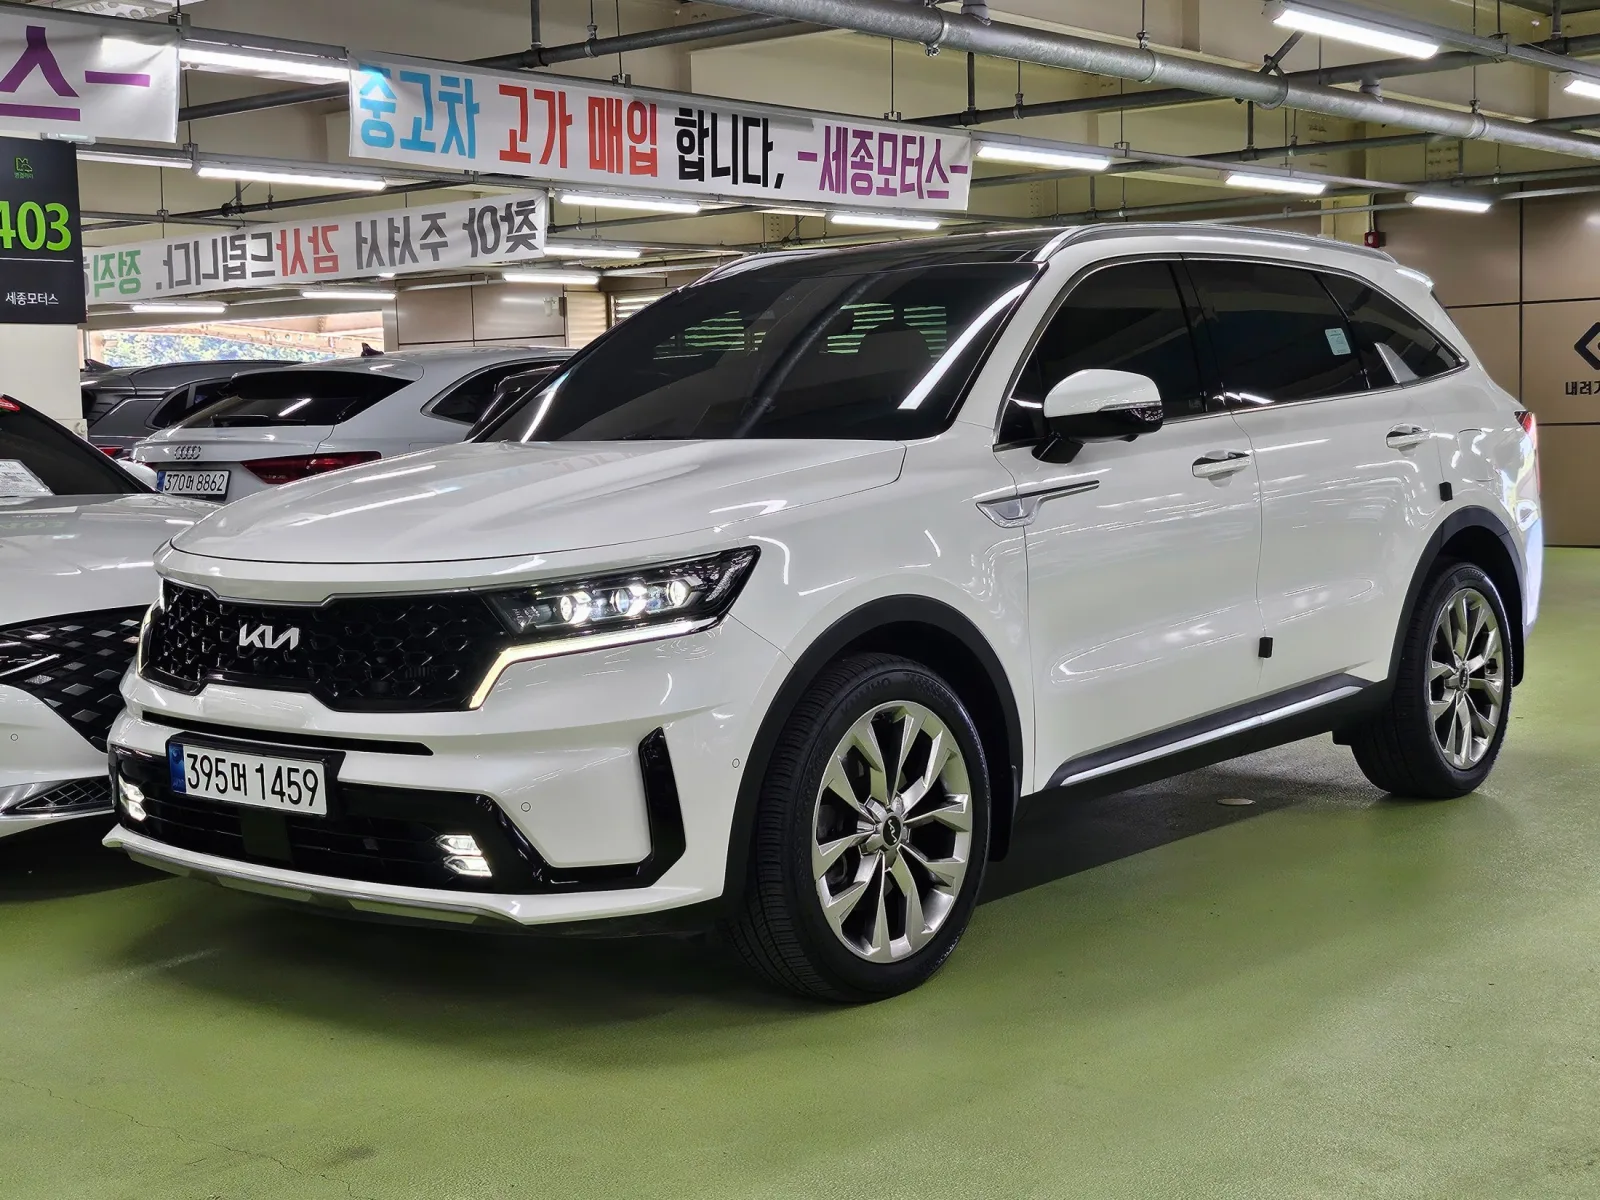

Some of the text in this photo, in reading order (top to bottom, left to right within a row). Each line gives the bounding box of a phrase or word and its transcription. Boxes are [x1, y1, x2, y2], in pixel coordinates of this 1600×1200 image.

[359, 64, 480, 159] 중고차
[498, 84, 573, 170] 고가
[587, 96, 658, 178] 매입
[674, 107, 784, 189] 합니다,
[5, 291, 60, 306] 세종모터스
[196, 473, 225, 492] 8862
[239, 623, 300, 650] KIA
[186, 752, 319, 807] 395머 1459
